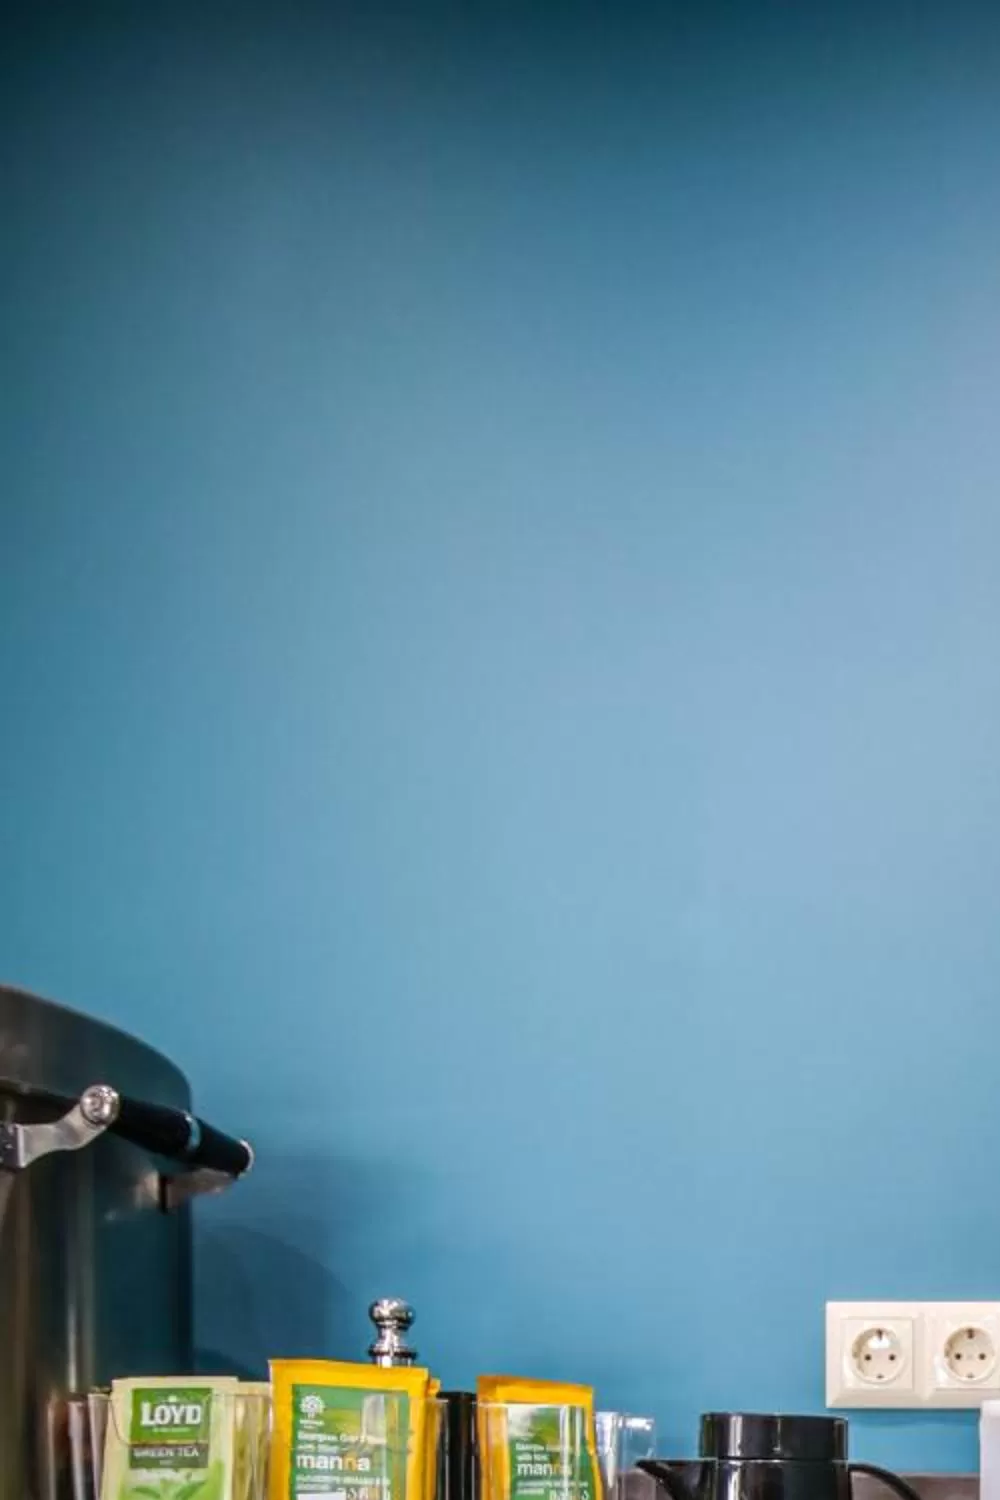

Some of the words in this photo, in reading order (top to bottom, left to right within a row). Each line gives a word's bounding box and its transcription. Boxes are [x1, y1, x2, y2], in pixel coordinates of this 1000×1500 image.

[141, 1401, 202, 1426] LOYD
[178, 1446, 200, 1457] TEA
[297, 1454, 371, 1471] manna
